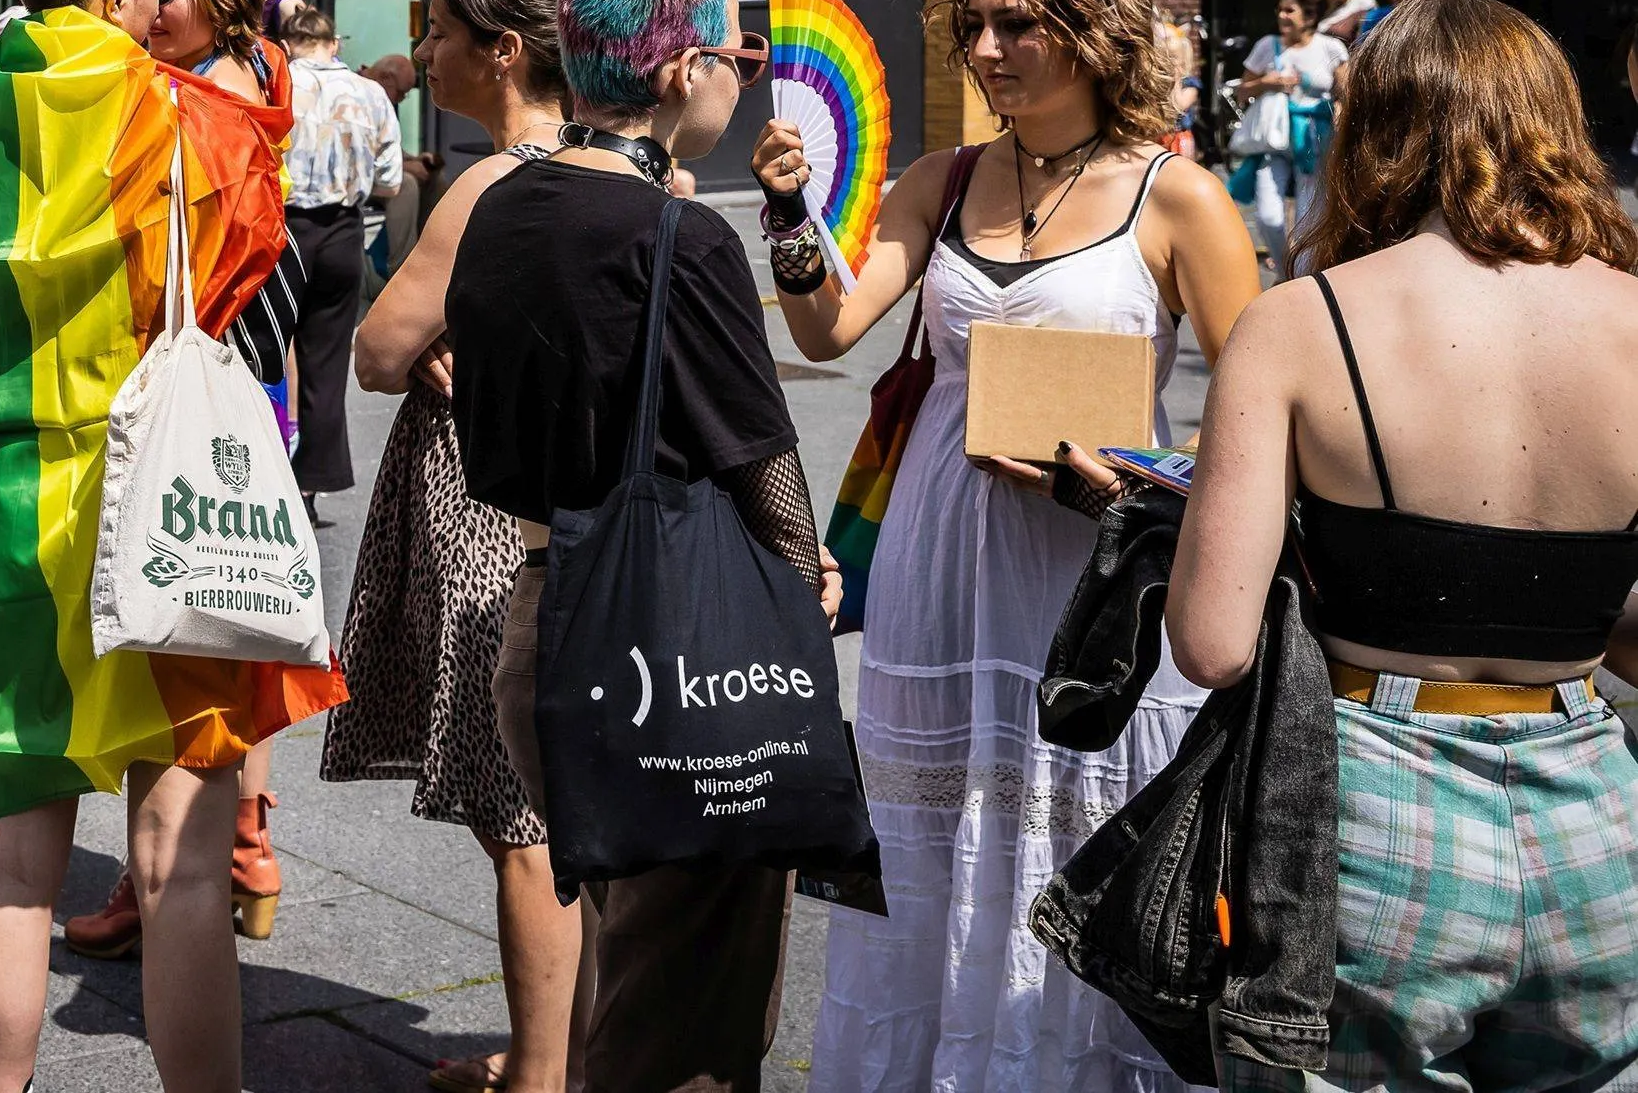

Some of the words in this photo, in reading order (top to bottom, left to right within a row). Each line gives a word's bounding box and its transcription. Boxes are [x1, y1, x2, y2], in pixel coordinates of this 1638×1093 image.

[160, 474, 298, 549] Brand
[219, 564, 258, 584] 1340
[184, 588, 292, 615] BIERBROUWERIJ
[677, 655, 815, 709] kroese
[638, 739, 809, 772] www.kroese-online.nl
[694, 770, 774, 796] Nijmegen
[703, 795, 767, 817] Arnhem
